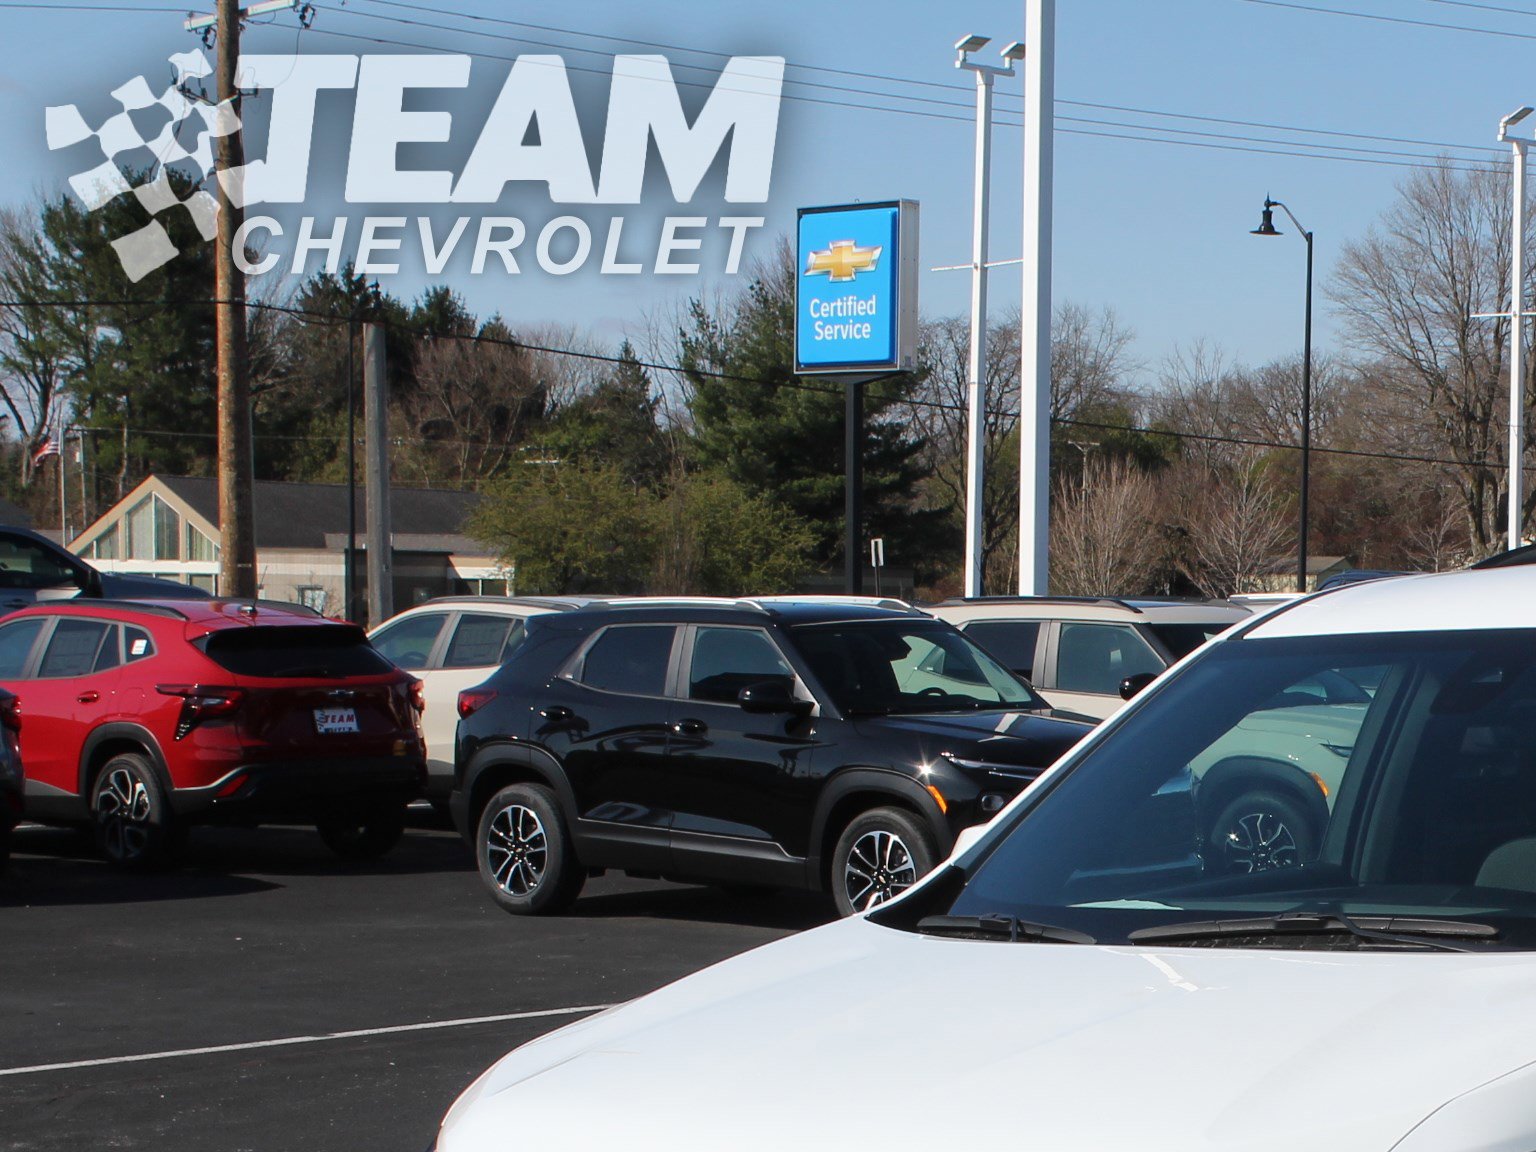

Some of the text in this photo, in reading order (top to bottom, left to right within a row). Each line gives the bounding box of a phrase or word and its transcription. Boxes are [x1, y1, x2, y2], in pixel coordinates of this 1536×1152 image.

[810, 294, 877, 319] Certified
[814, 319, 872, 341] Service
[323, 714, 355, 724] TEAM
